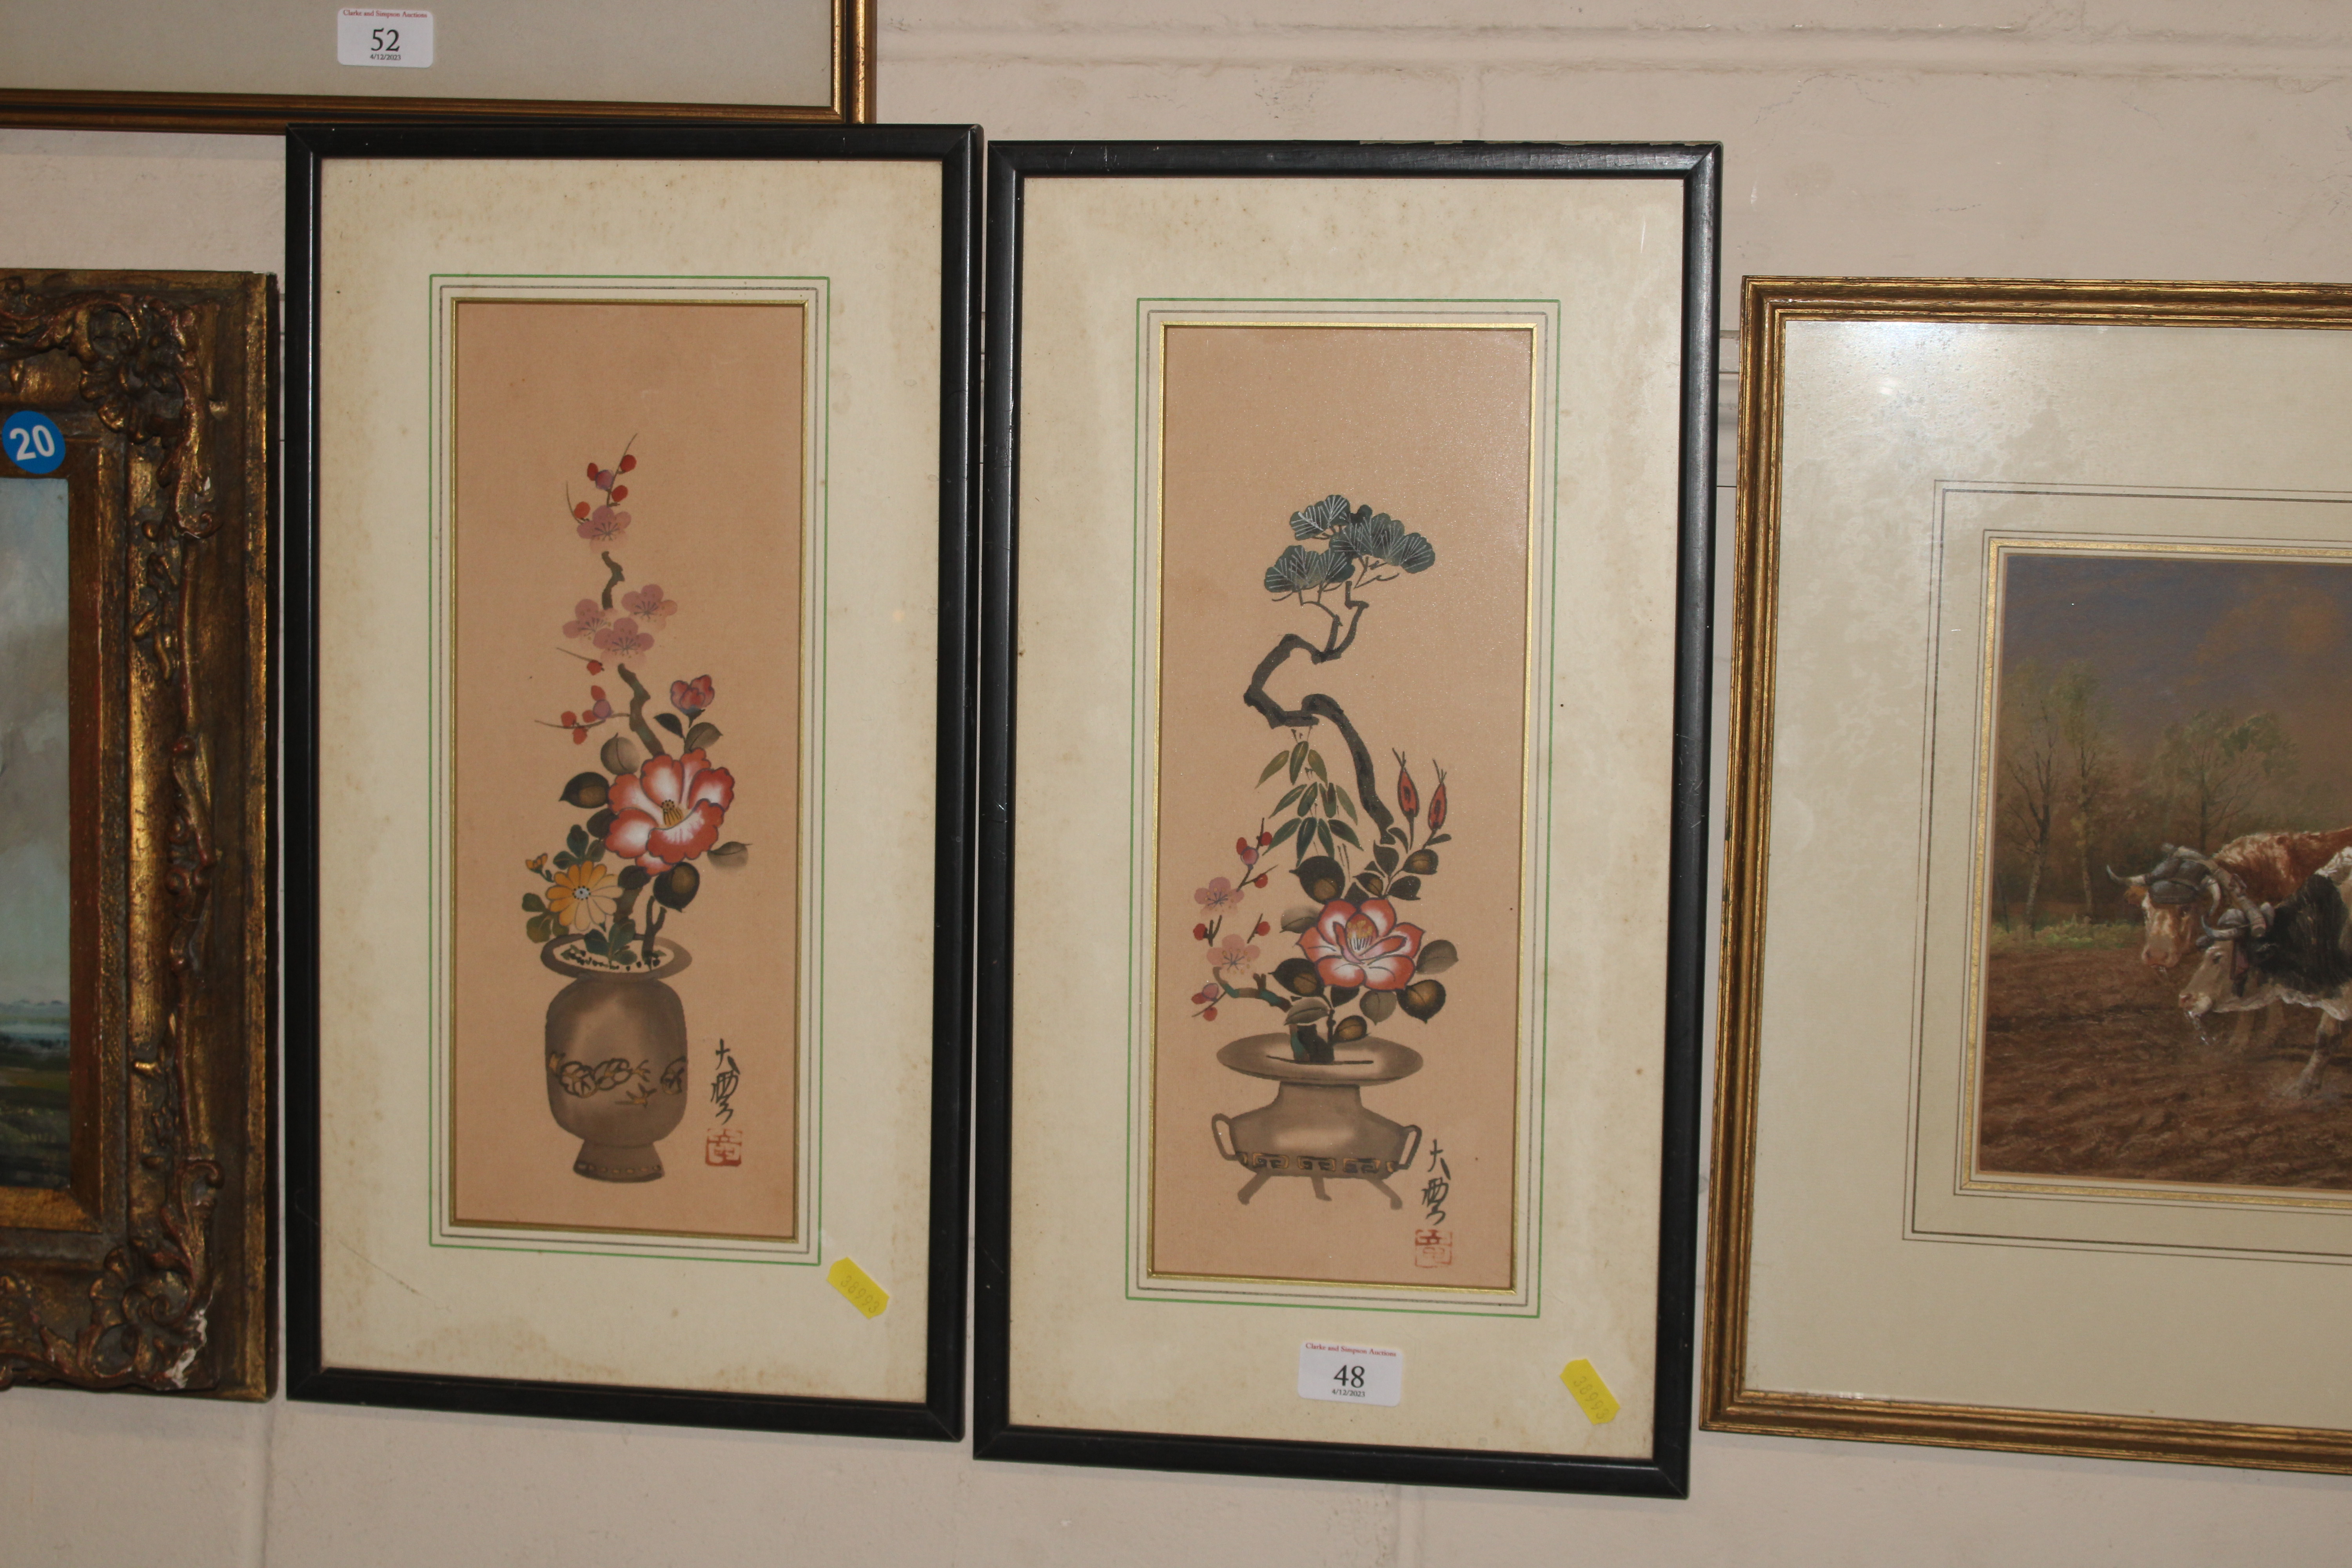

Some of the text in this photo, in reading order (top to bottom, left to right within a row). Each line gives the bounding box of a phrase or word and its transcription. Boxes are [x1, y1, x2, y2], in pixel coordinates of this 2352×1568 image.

[376, 10, 400, 18] Simpson
[371, 27, 400, 52] 52
[10, 425, 55, 461] 20
[840, 1275, 880, 1313] 38993
[1341, 1346, 1367, 1355] Simpson
[1369, 1348, 1397, 1357] Auctions
[1334, 1365, 1365, 1388] 48
[1332, 1389, 1366, 1397] 4/12/2023
[1573, 1376, 1609, 1419] 38993
